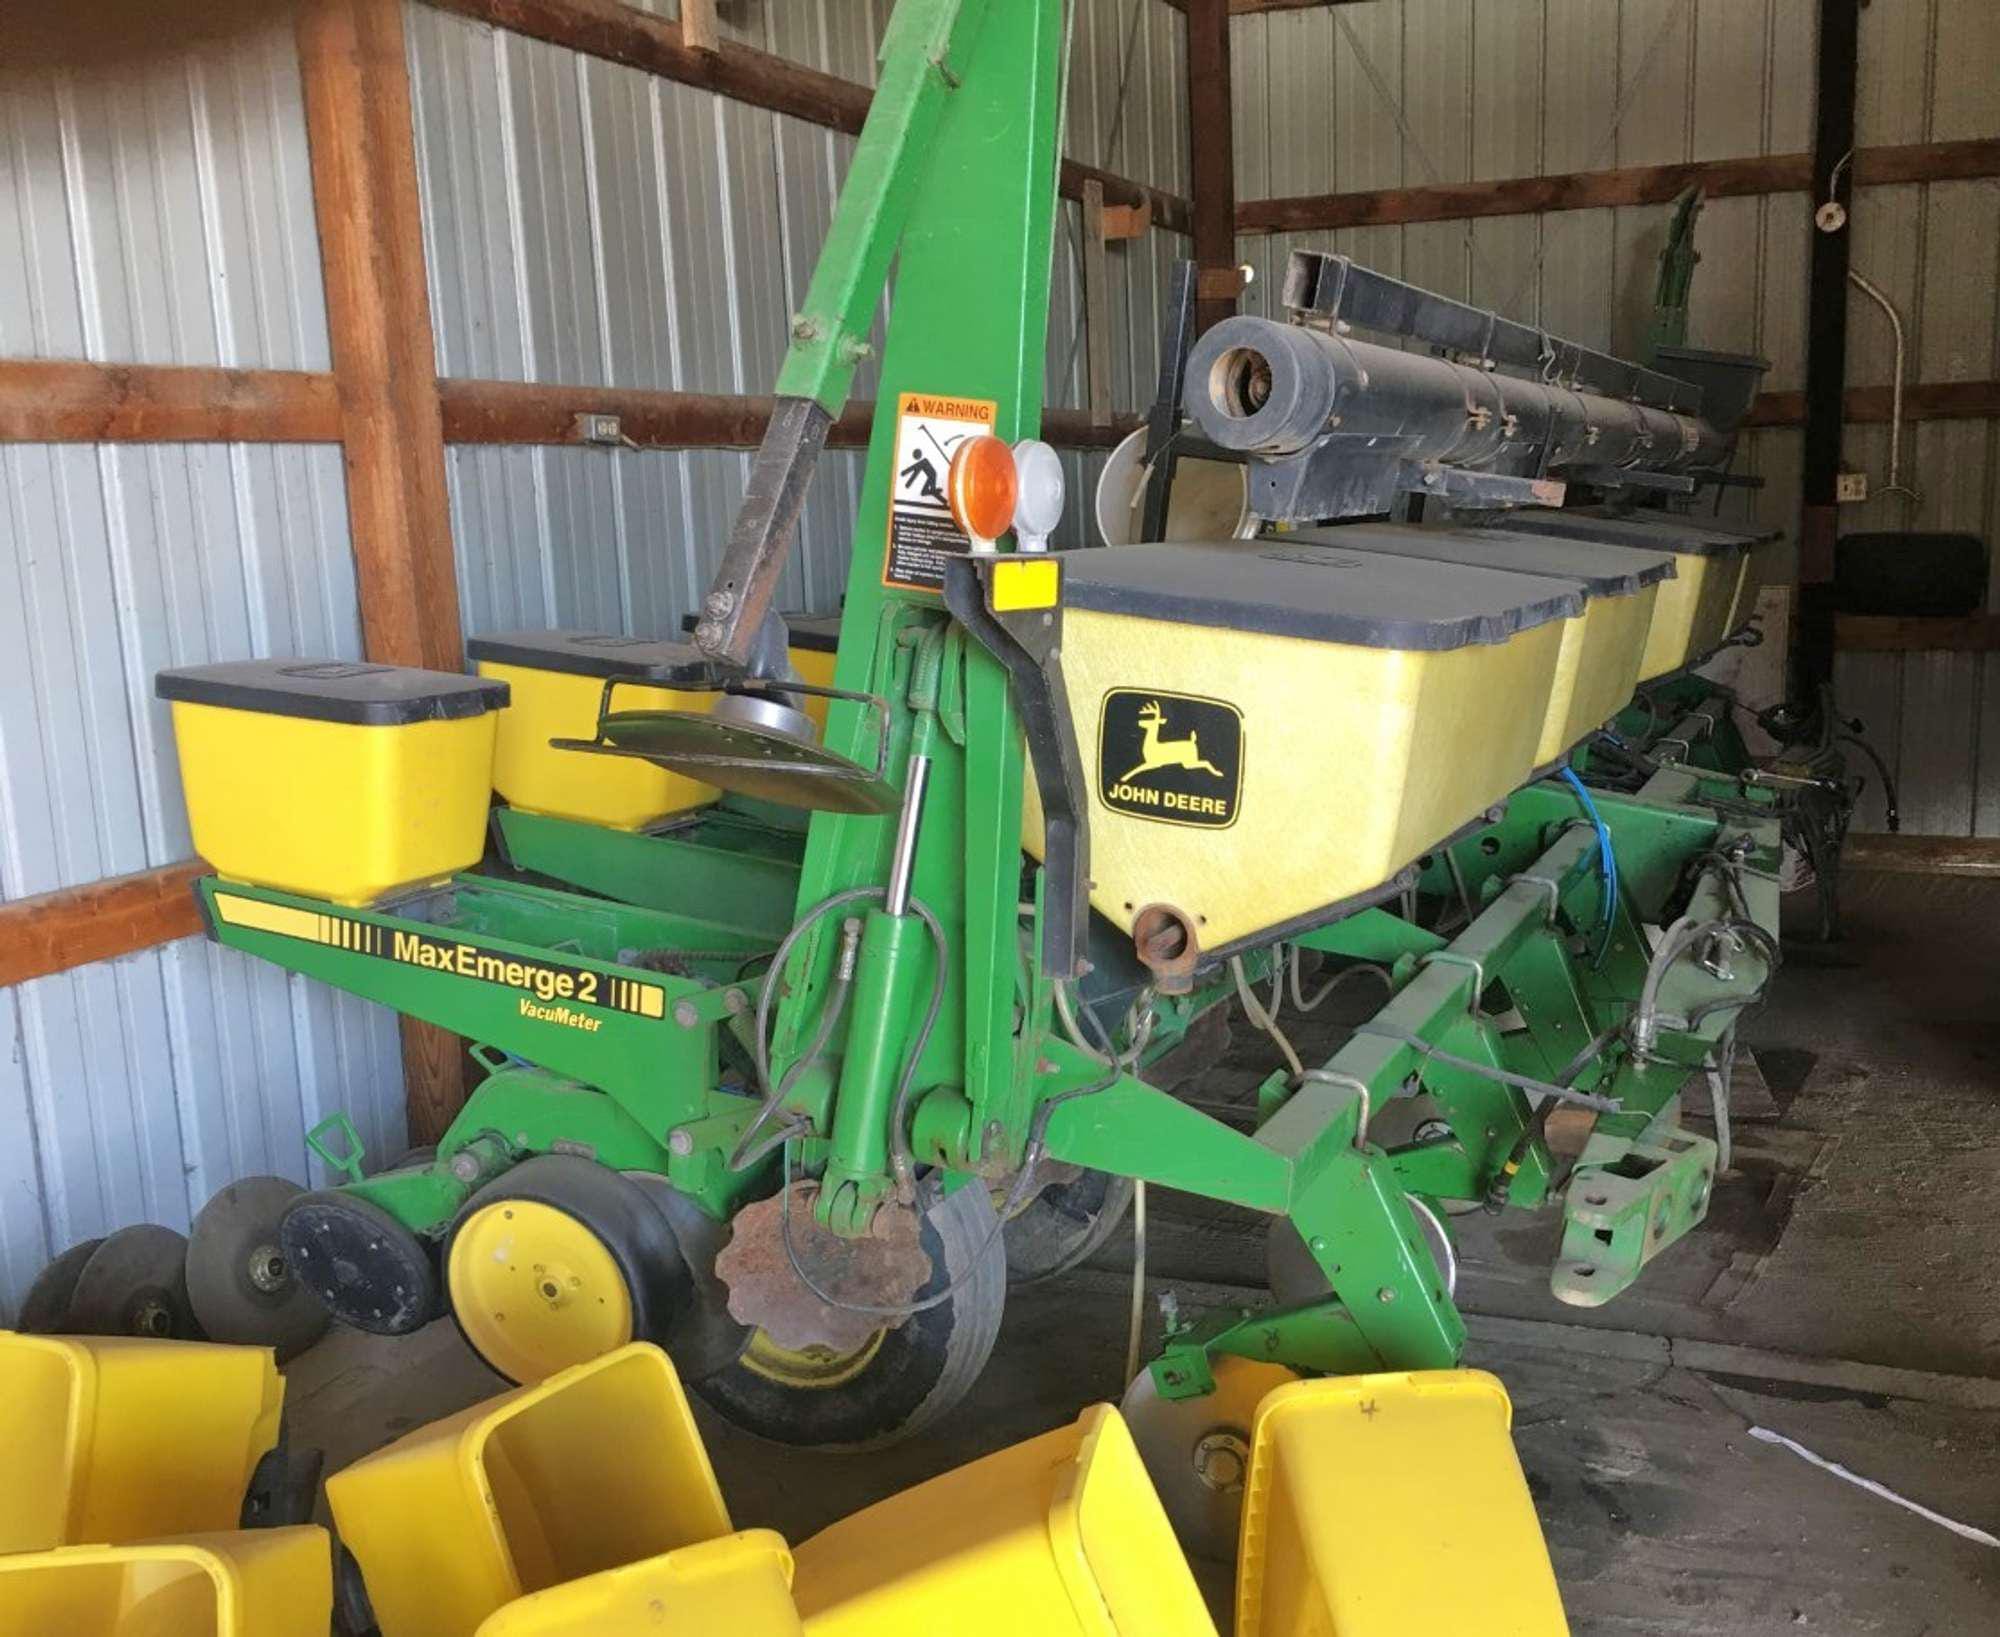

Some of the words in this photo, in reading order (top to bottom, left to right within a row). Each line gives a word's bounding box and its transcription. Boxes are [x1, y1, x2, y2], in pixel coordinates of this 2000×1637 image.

[923, 399, 989, 420] WARNING
[1109, 784, 1159, 805] JOHN
[1164, 792, 1226, 816] DEERE
[520, 998, 602, 1032] VacuMeter
